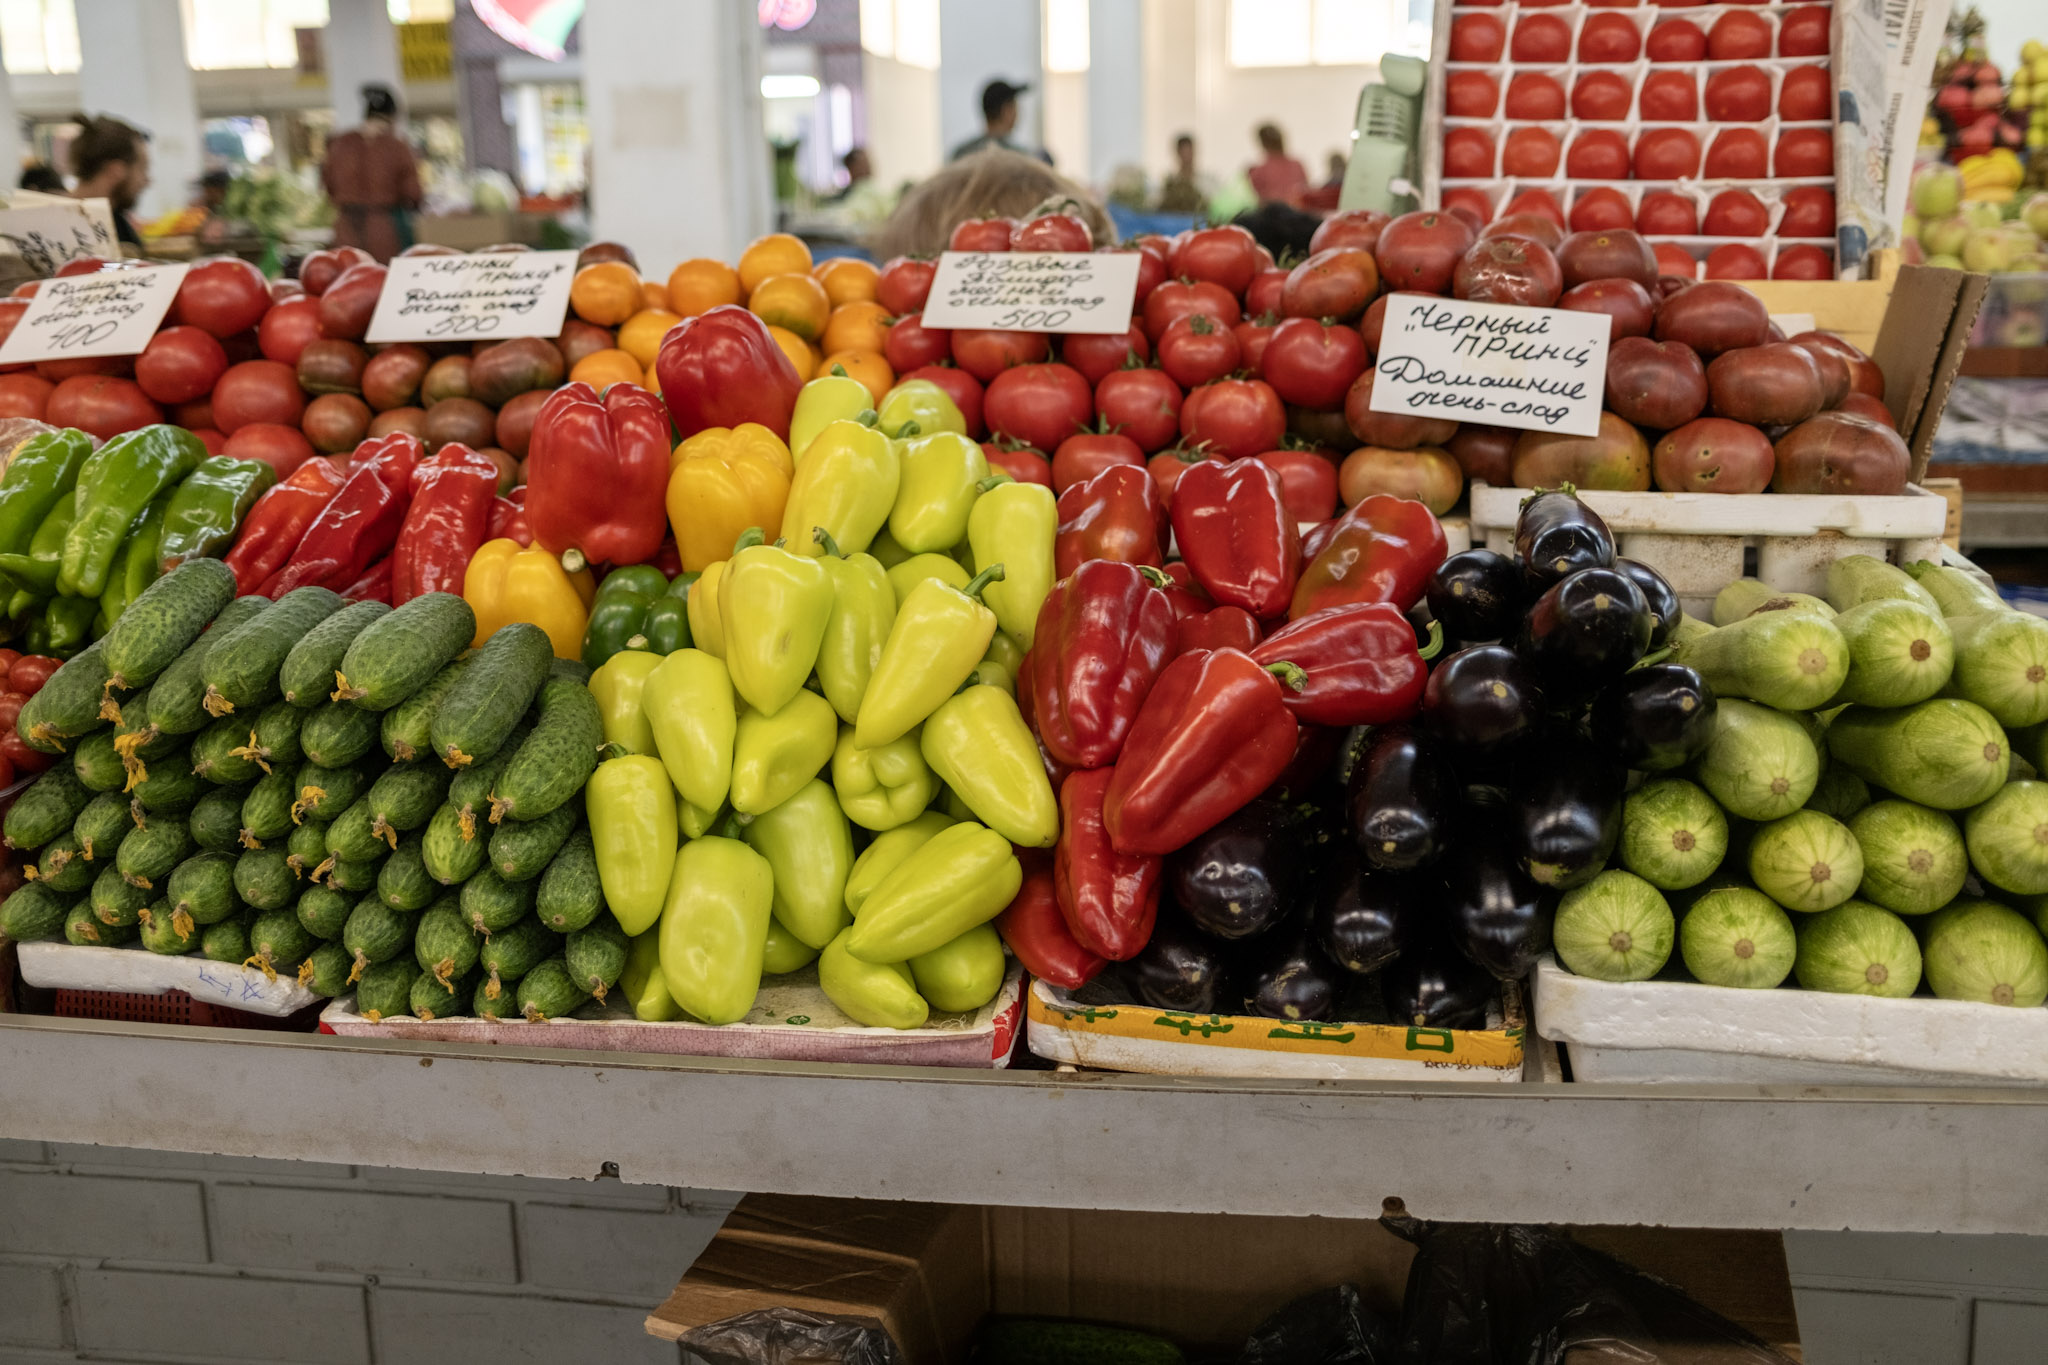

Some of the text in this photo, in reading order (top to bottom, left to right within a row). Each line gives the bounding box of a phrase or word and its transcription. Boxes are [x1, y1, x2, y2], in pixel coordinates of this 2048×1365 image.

[426, 316, 500, 335] 500
[991, 308, 1073, 329] 500
[46, 320, 119, 350] 400
[1379, 355, 1588, 400] Домашние
